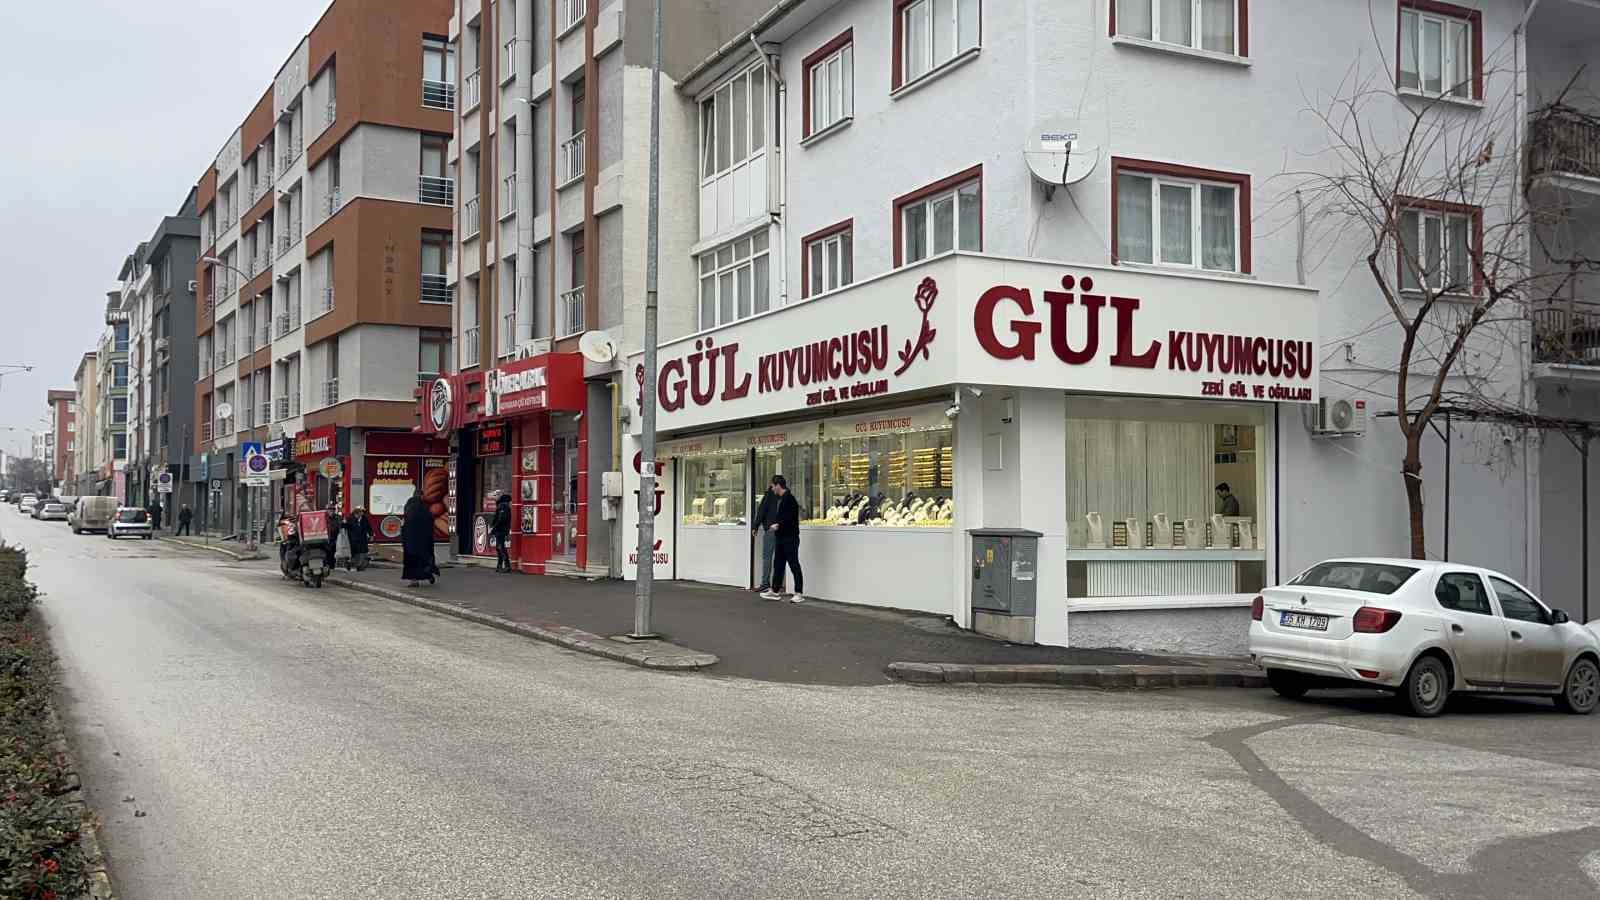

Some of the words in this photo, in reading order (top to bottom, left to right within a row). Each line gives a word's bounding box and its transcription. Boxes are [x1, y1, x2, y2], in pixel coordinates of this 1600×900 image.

[1040, 133, 1078, 141] BEKO
[974, 275, 1162, 369] GÜL
[1168, 331, 1313, 379] KUYUMCUSU
[657, 336, 752, 413] GÜL
[758, 324, 888, 394] KUYUMCUSU
[1201, 379, 1224, 396] ZEKİ
[1229, 381, 1248, 397] GÜL
[1252, 384, 1265, 398] VE
[1268, 383, 1312, 400] OĞULLARI
